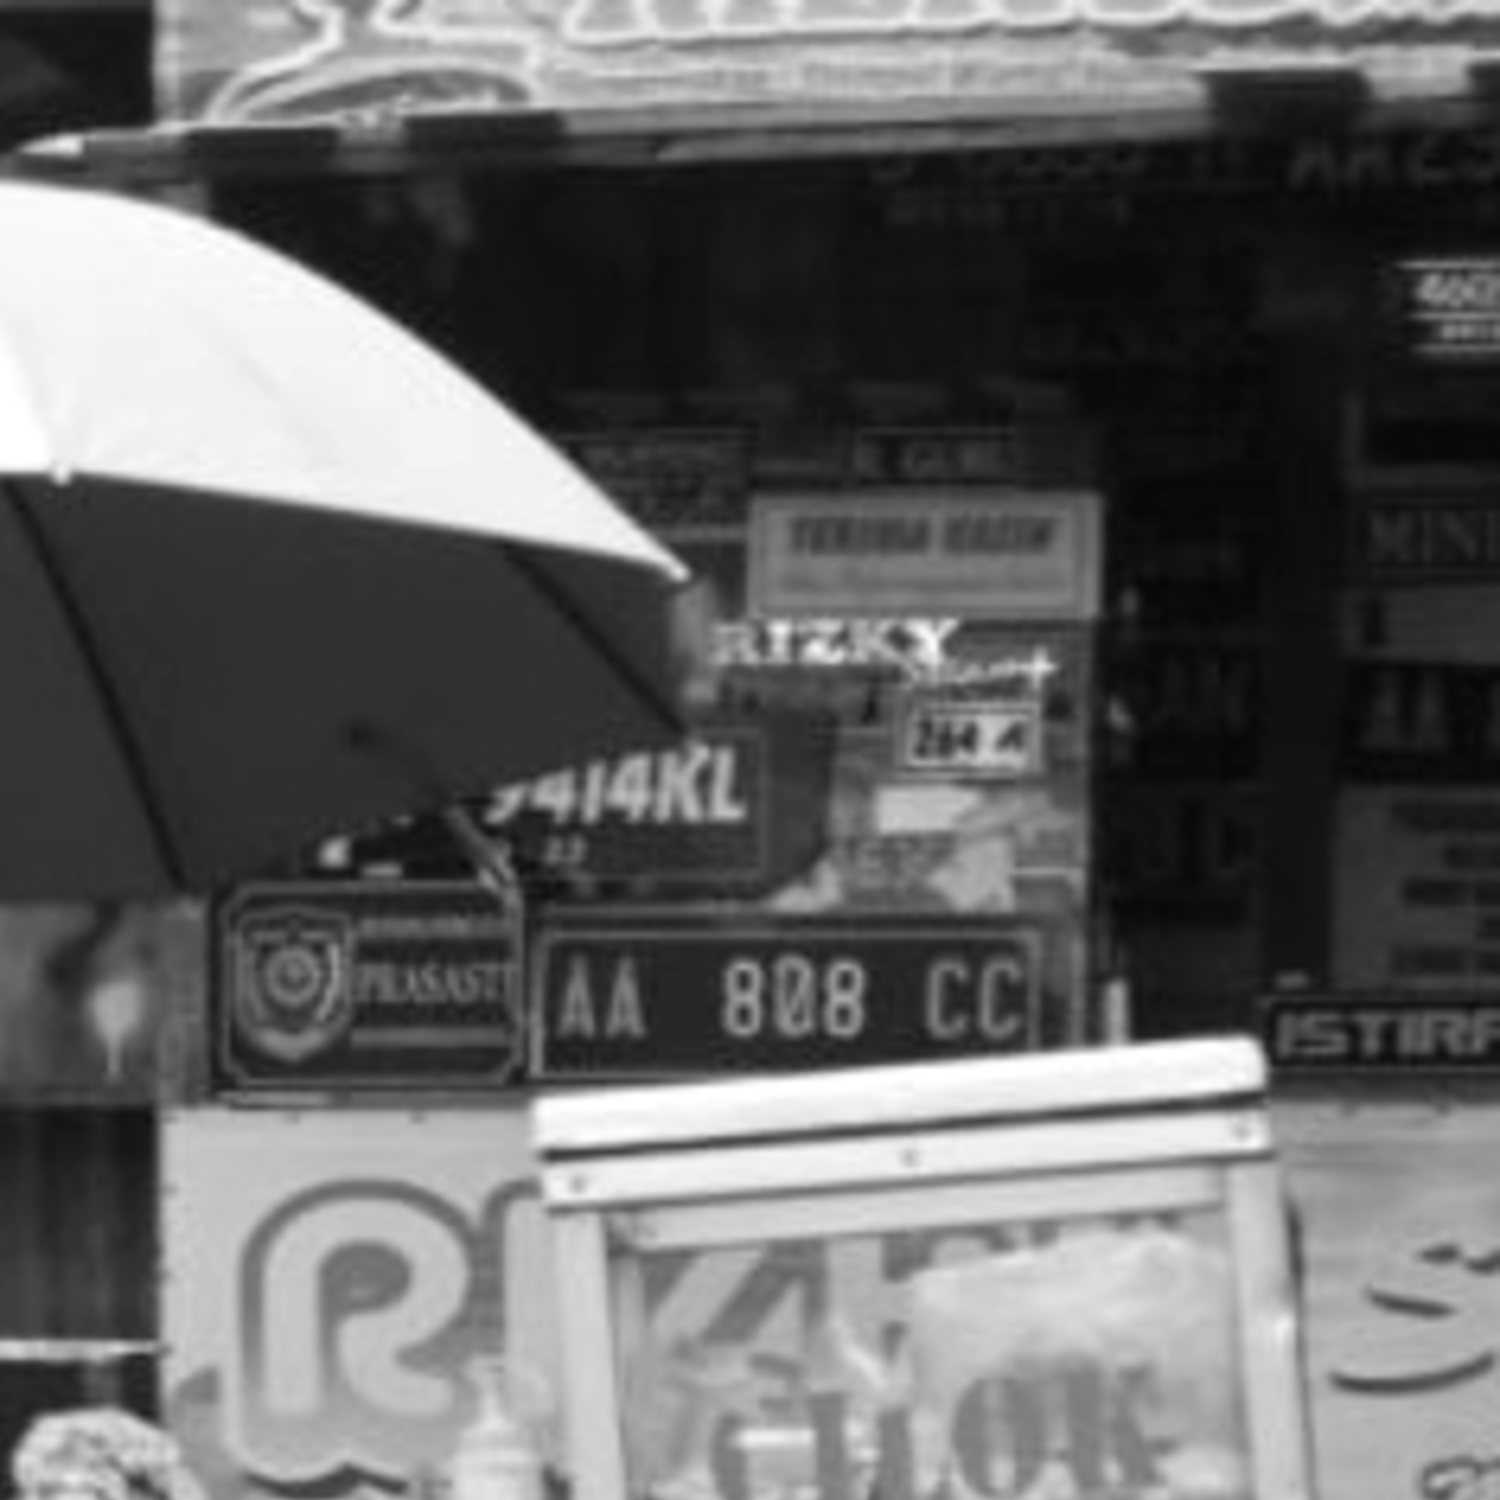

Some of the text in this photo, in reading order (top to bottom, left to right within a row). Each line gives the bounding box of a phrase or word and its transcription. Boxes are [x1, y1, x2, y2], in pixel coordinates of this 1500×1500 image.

[1366, 508, 1500, 564] MIN
[708, 616, 960, 668] RIZKY
[558, 956, 646, 1038] AA
[926, 958, 1024, 1040] CC
